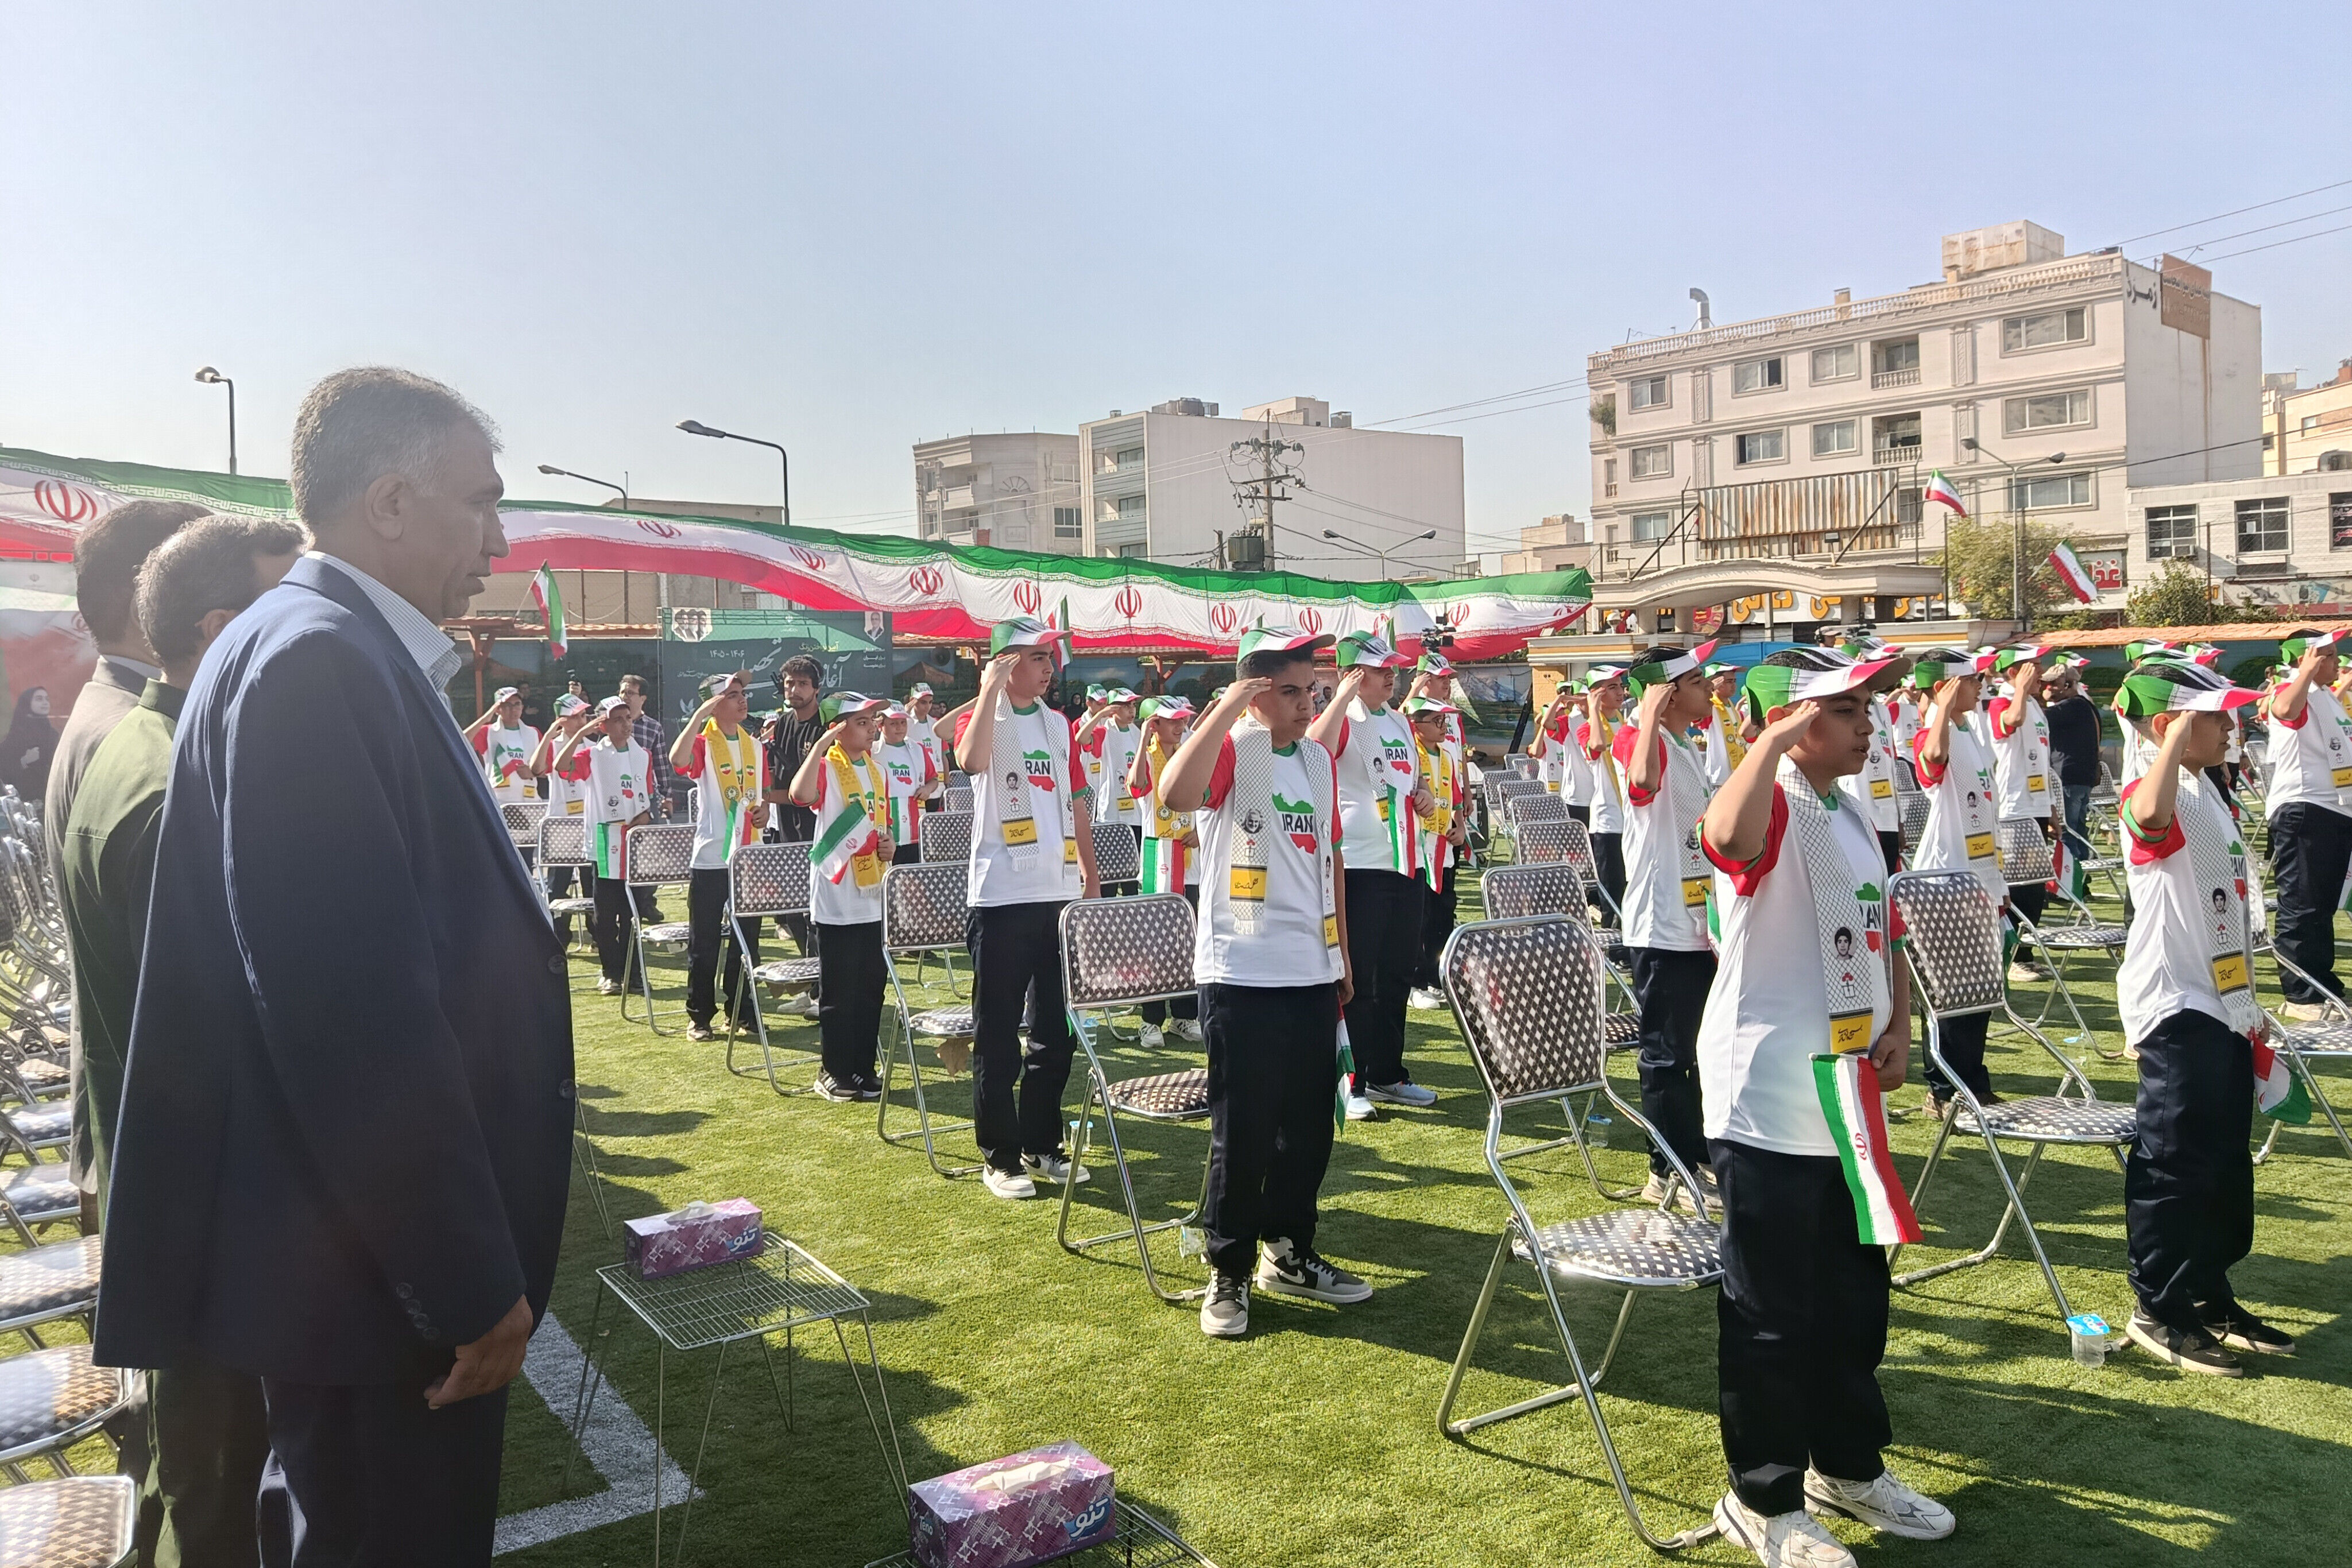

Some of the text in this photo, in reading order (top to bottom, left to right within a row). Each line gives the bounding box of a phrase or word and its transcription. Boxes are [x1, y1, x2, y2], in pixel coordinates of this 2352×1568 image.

[1385, 748, 1408, 760] IRAN
[1025, 760, 1051, 775] RAN
[621, 781, 632, 789] AN
[1282, 814, 1313, 833] IRAN
[919, 1515, 933, 1536] Teno
[1070, 1497, 1108, 1538] تنو
